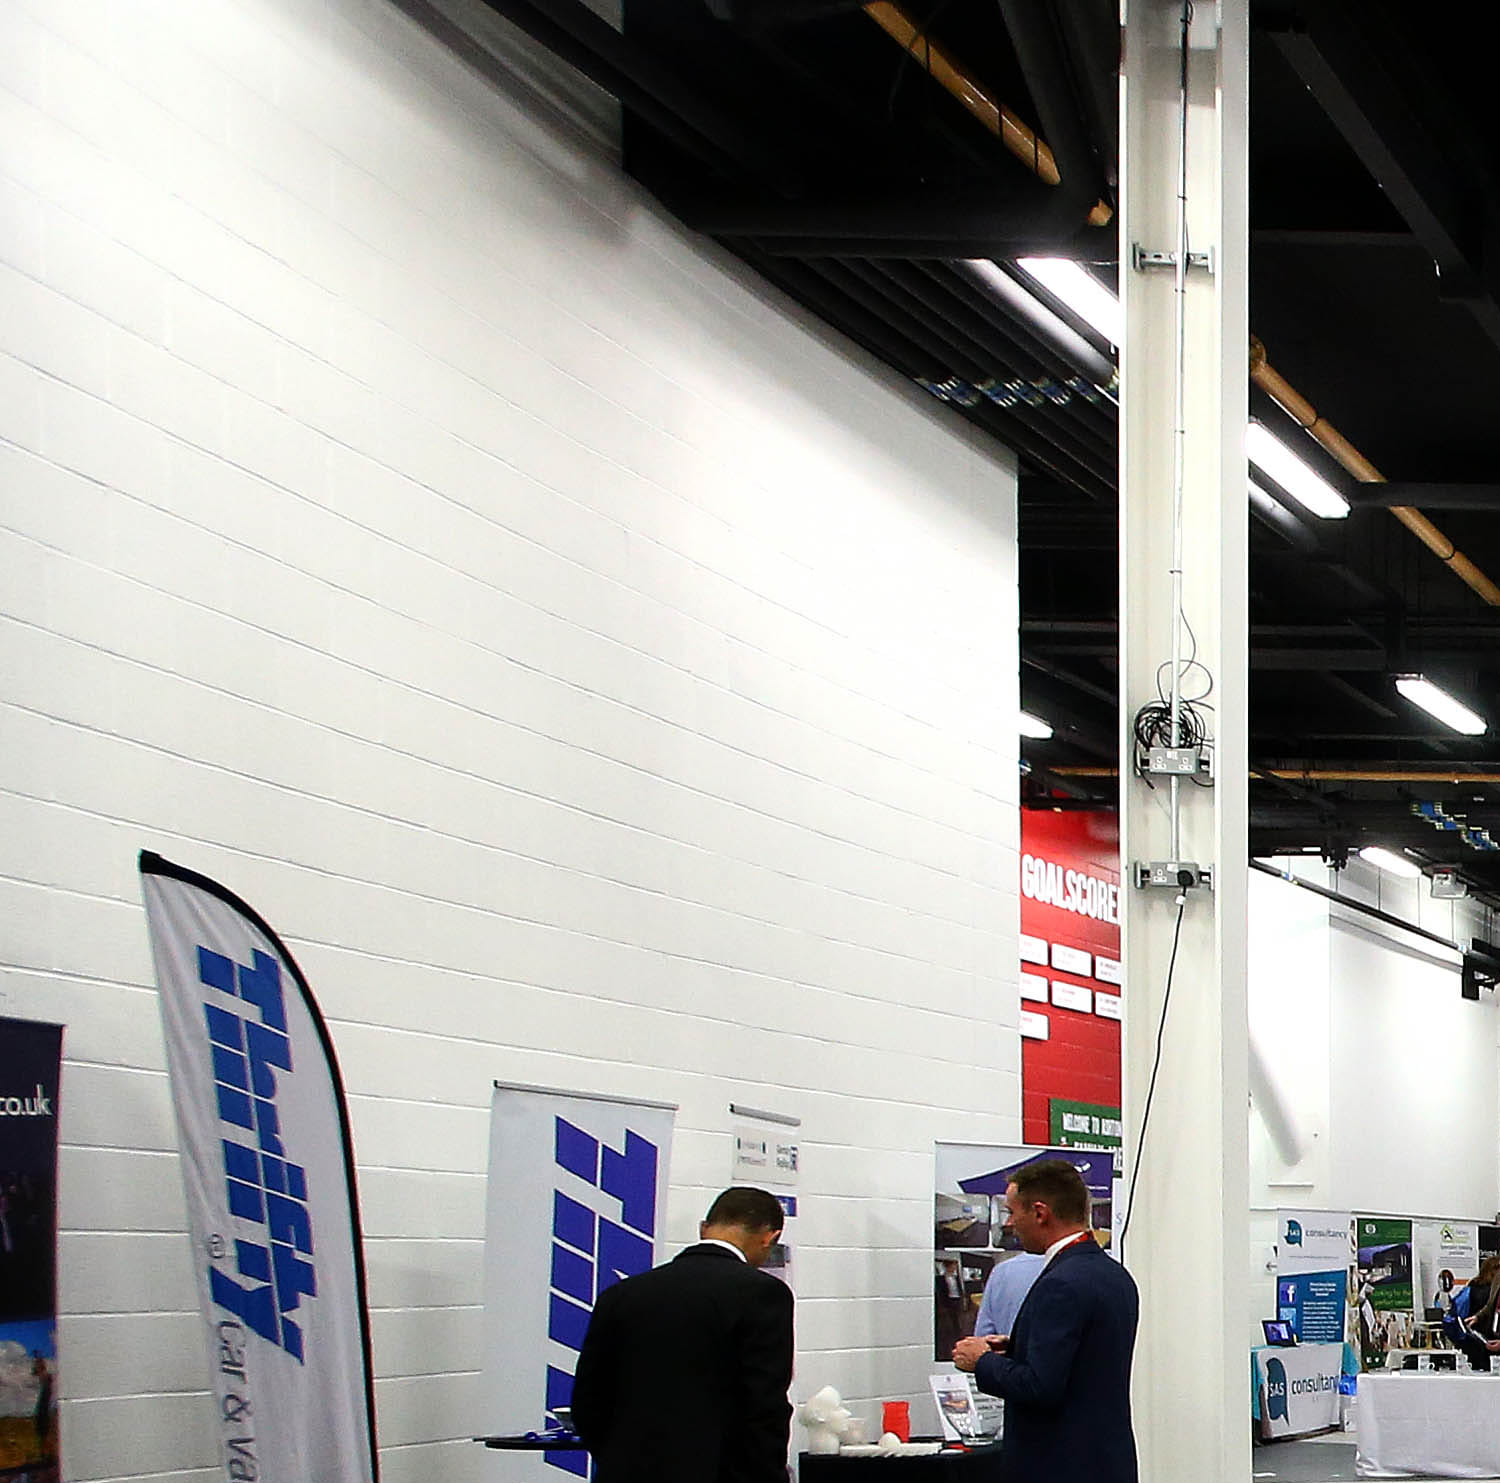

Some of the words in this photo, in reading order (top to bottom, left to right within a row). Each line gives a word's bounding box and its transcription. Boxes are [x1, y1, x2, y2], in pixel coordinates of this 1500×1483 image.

[198, 945, 319, 1366] Thrifty
[1305, 1229, 1347, 1239] consultancy
[217, 1321, 248, 1385] Car
[1269, 1382, 1285, 1397] SAS
[222, 1393, 252, 1423] &
